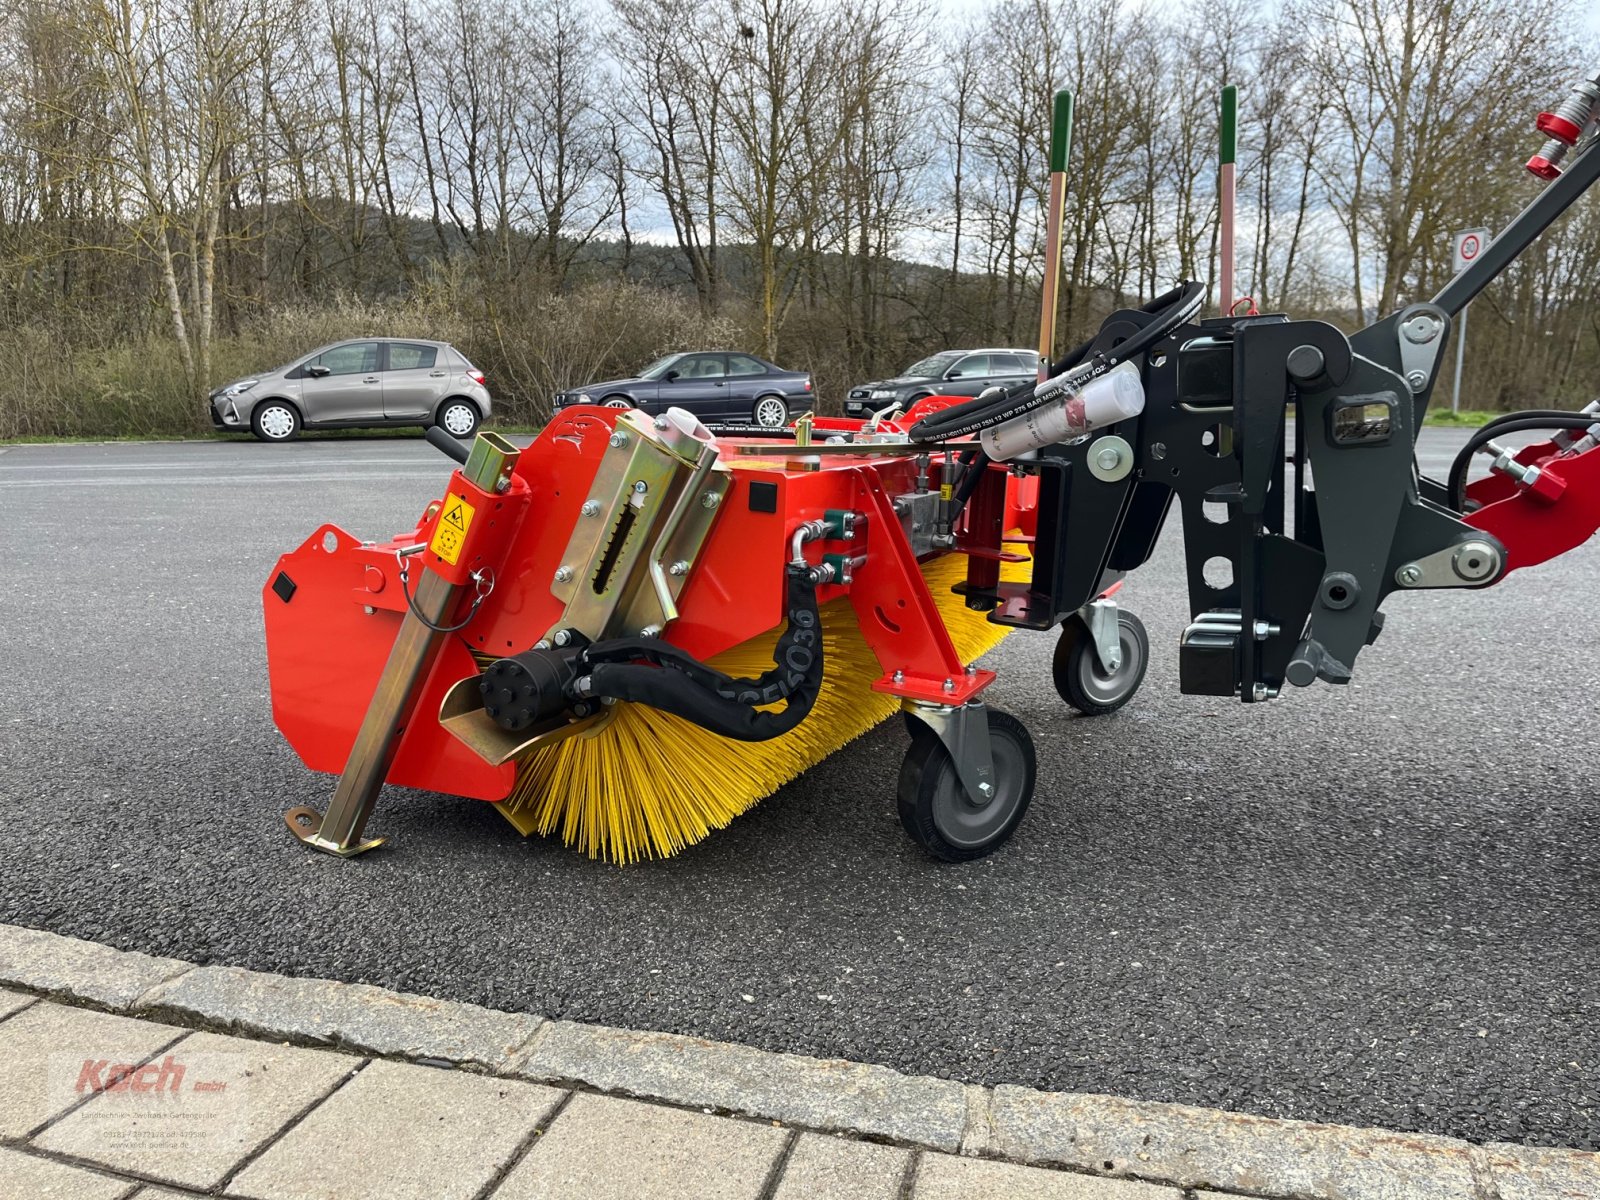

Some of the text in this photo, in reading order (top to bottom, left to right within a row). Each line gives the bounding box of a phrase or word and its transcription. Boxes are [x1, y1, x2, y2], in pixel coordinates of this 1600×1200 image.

[1465, 242, 1475, 254] 30
[994, 415, 1003, 423] 12
[1002, 410, 1014, 419] WP
[1014, 404, 1027, 414] 275
[1026, 396, 1042, 409] BAR
[1042, 387, 1063, 402] MSHA
[437, 545, 451, 556] STOP
